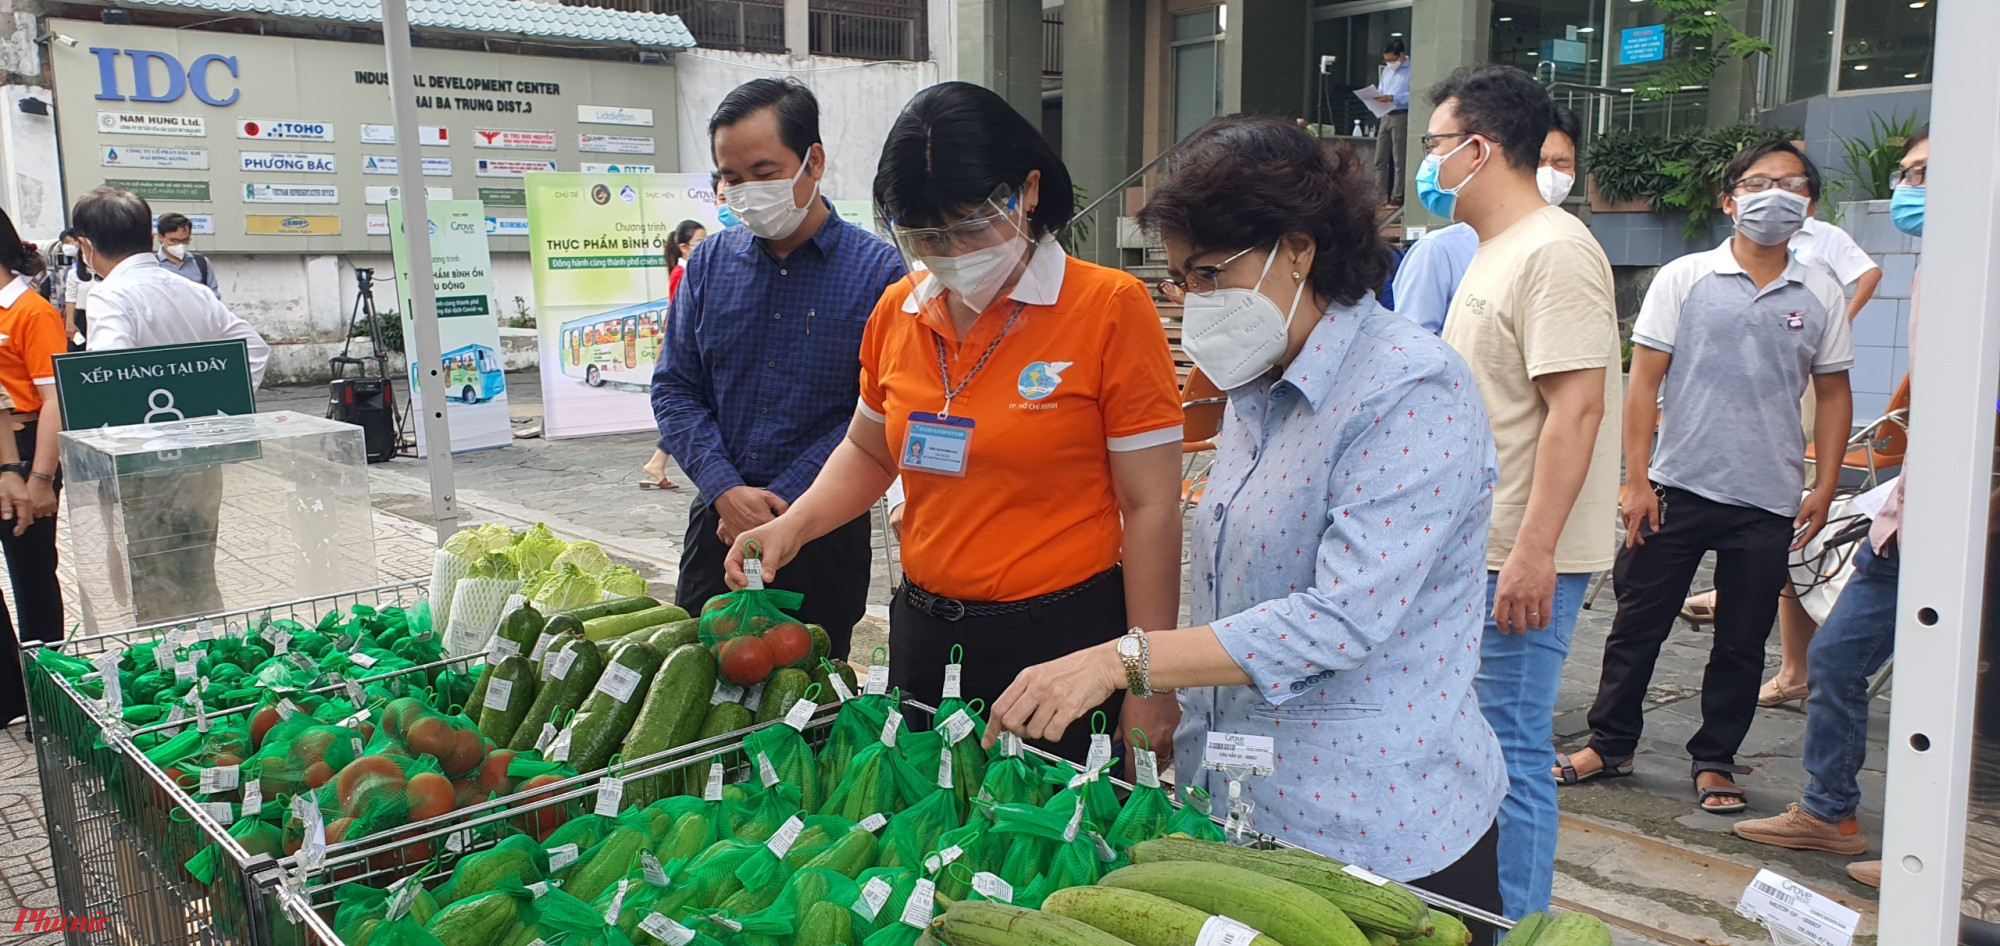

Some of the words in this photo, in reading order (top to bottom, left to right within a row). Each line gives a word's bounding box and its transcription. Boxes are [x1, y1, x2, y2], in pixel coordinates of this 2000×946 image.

[89, 47, 240, 107] IDC
[429, 75, 513, 92] DEVELOPMENT
[516, 80, 560, 95] CENTER
[436, 97, 452, 109] BA
[455, 98, 494, 112] TRUNG
[120, 115, 144, 123] NAM
[149, 116, 178, 125] HUNG
[181, 118, 201, 126] Ltd.
[284, 124, 324, 134] TOHO
[244, 159, 304, 169] PHƯƠNG
[307, 158, 333, 170] BẮC
[450, 221, 475, 231] Grove
[615, 222, 646, 234] Chương
[647, 221, 667, 232] trình
[547, 238, 580, 253] THỰC
[584, 234, 618, 250] PHẨM
[622, 238, 649, 249] BÌNH
[552, 258, 571, 269] Đồng
[572, 258, 589, 267] hành
[590, 259, 606, 268] cùng
[607, 257, 625, 266] thành
[626, 256, 639, 267] phố
[452, 269, 470, 278] BÌNH
[442, 281, 466, 292] ĐỘNG
[80, 366, 113, 384] XẾP
[116, 364, 164, 380] HÀNG
[167, 362, 193, 377] TẠI
[196, 357, 227, 373] ĐÂY
[1225, 734, 1245, 742] Grove
[1782, 880, 1813, 900] Grove
